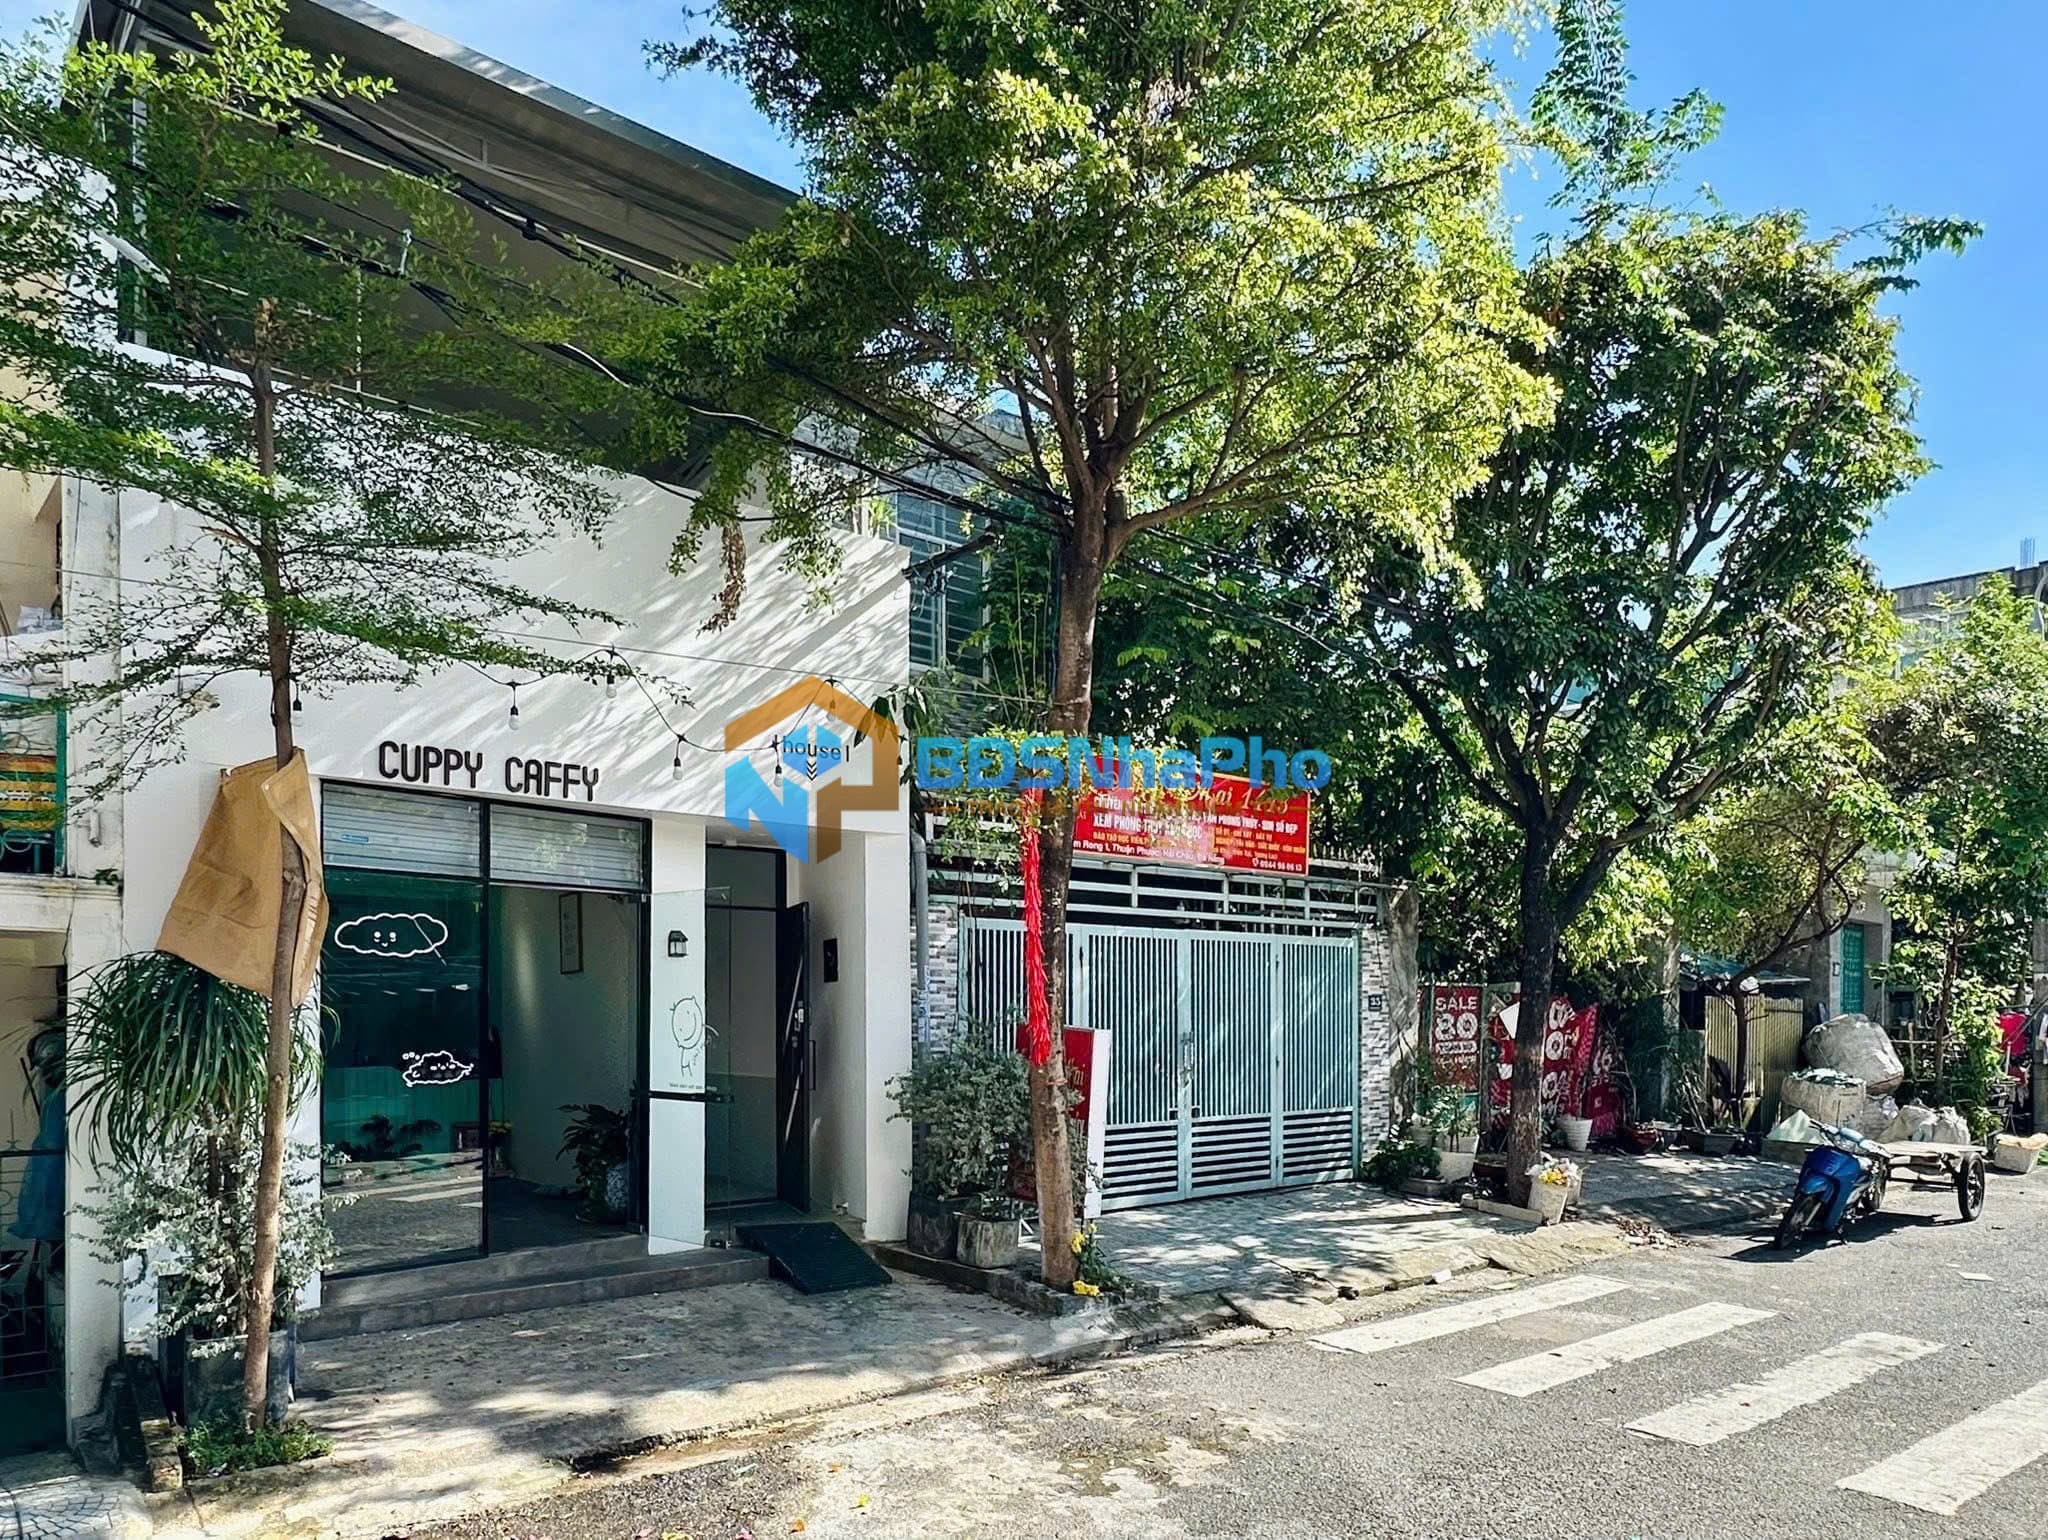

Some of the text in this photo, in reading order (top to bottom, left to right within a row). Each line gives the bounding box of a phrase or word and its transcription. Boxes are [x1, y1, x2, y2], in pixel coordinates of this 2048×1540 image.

[379, 741, 599, 801] CUPPY CAFFY
[1435, 996, 1478, 1011] SALE
